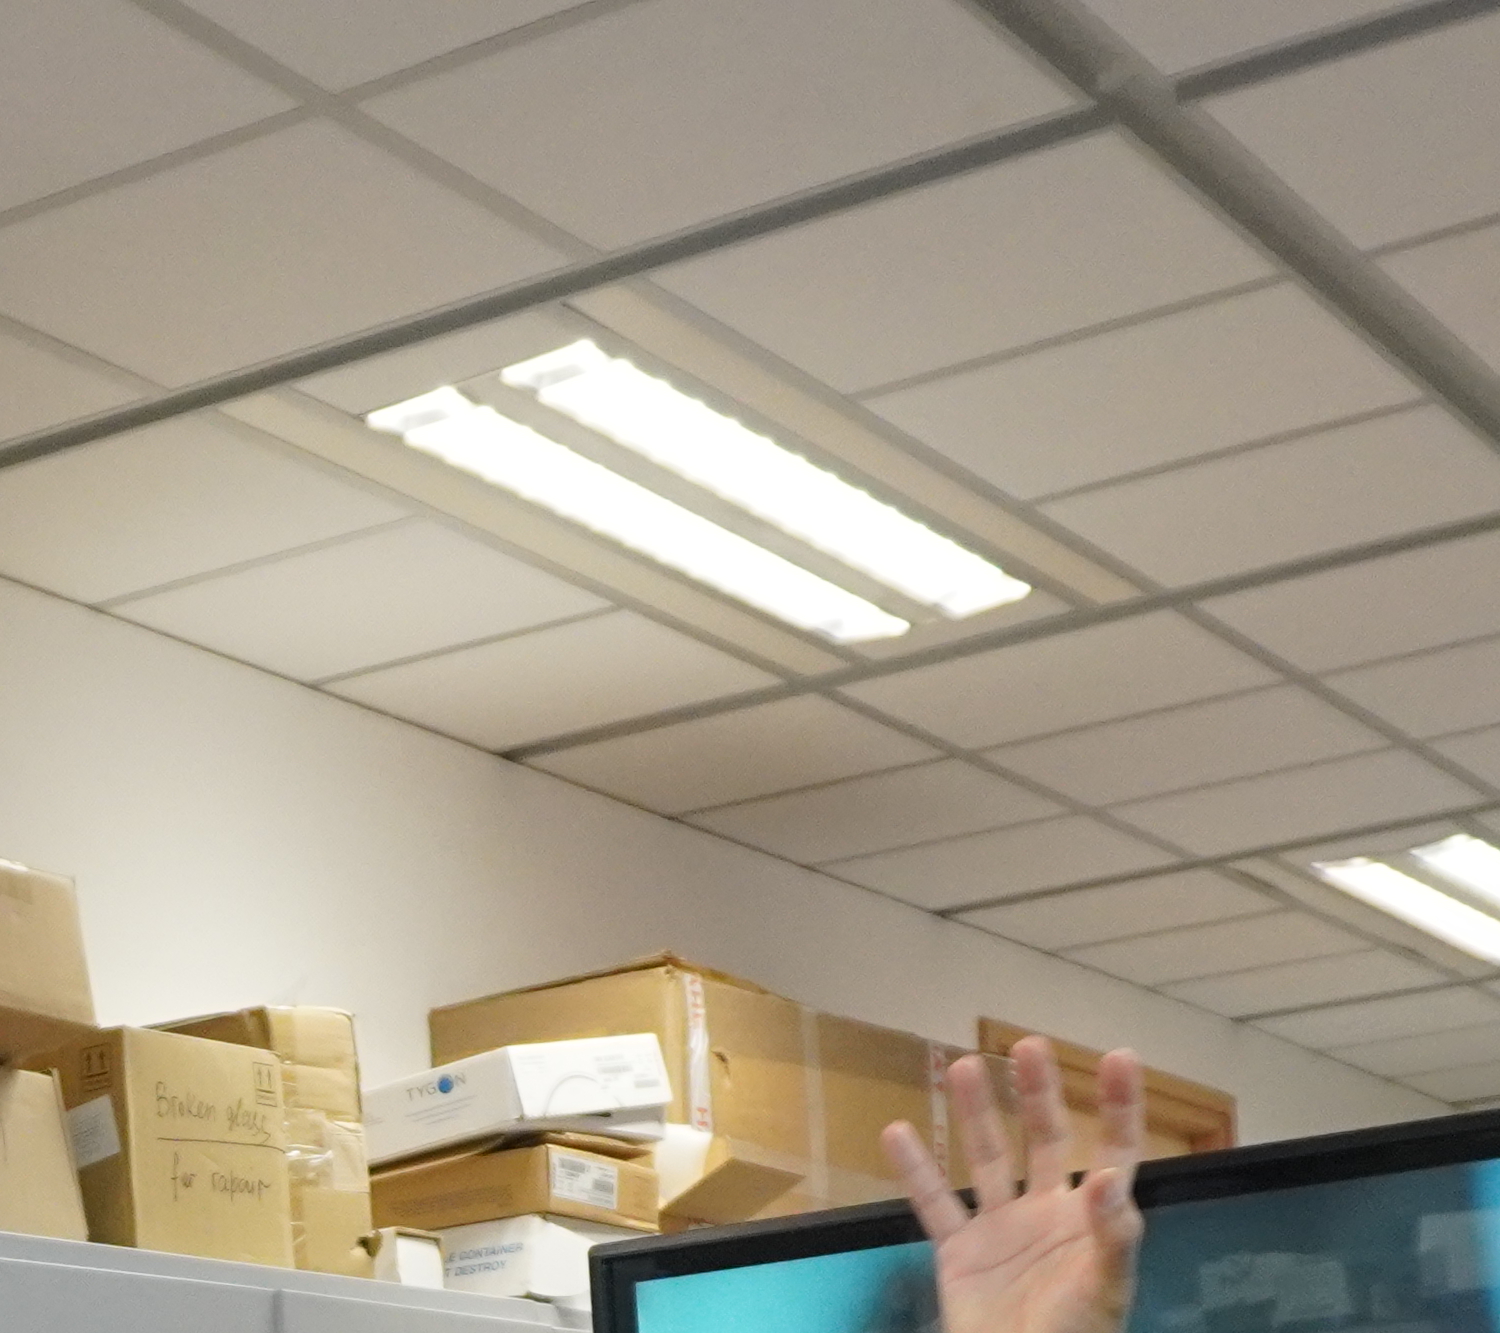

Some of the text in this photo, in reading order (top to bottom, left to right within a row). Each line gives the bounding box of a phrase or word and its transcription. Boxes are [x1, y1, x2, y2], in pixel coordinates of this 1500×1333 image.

[155, 1081, 216, 1122] Broken
[459, 1242, 524, 1262] CONTAINER
[455, 1259, 508, 1277] DESTROY
